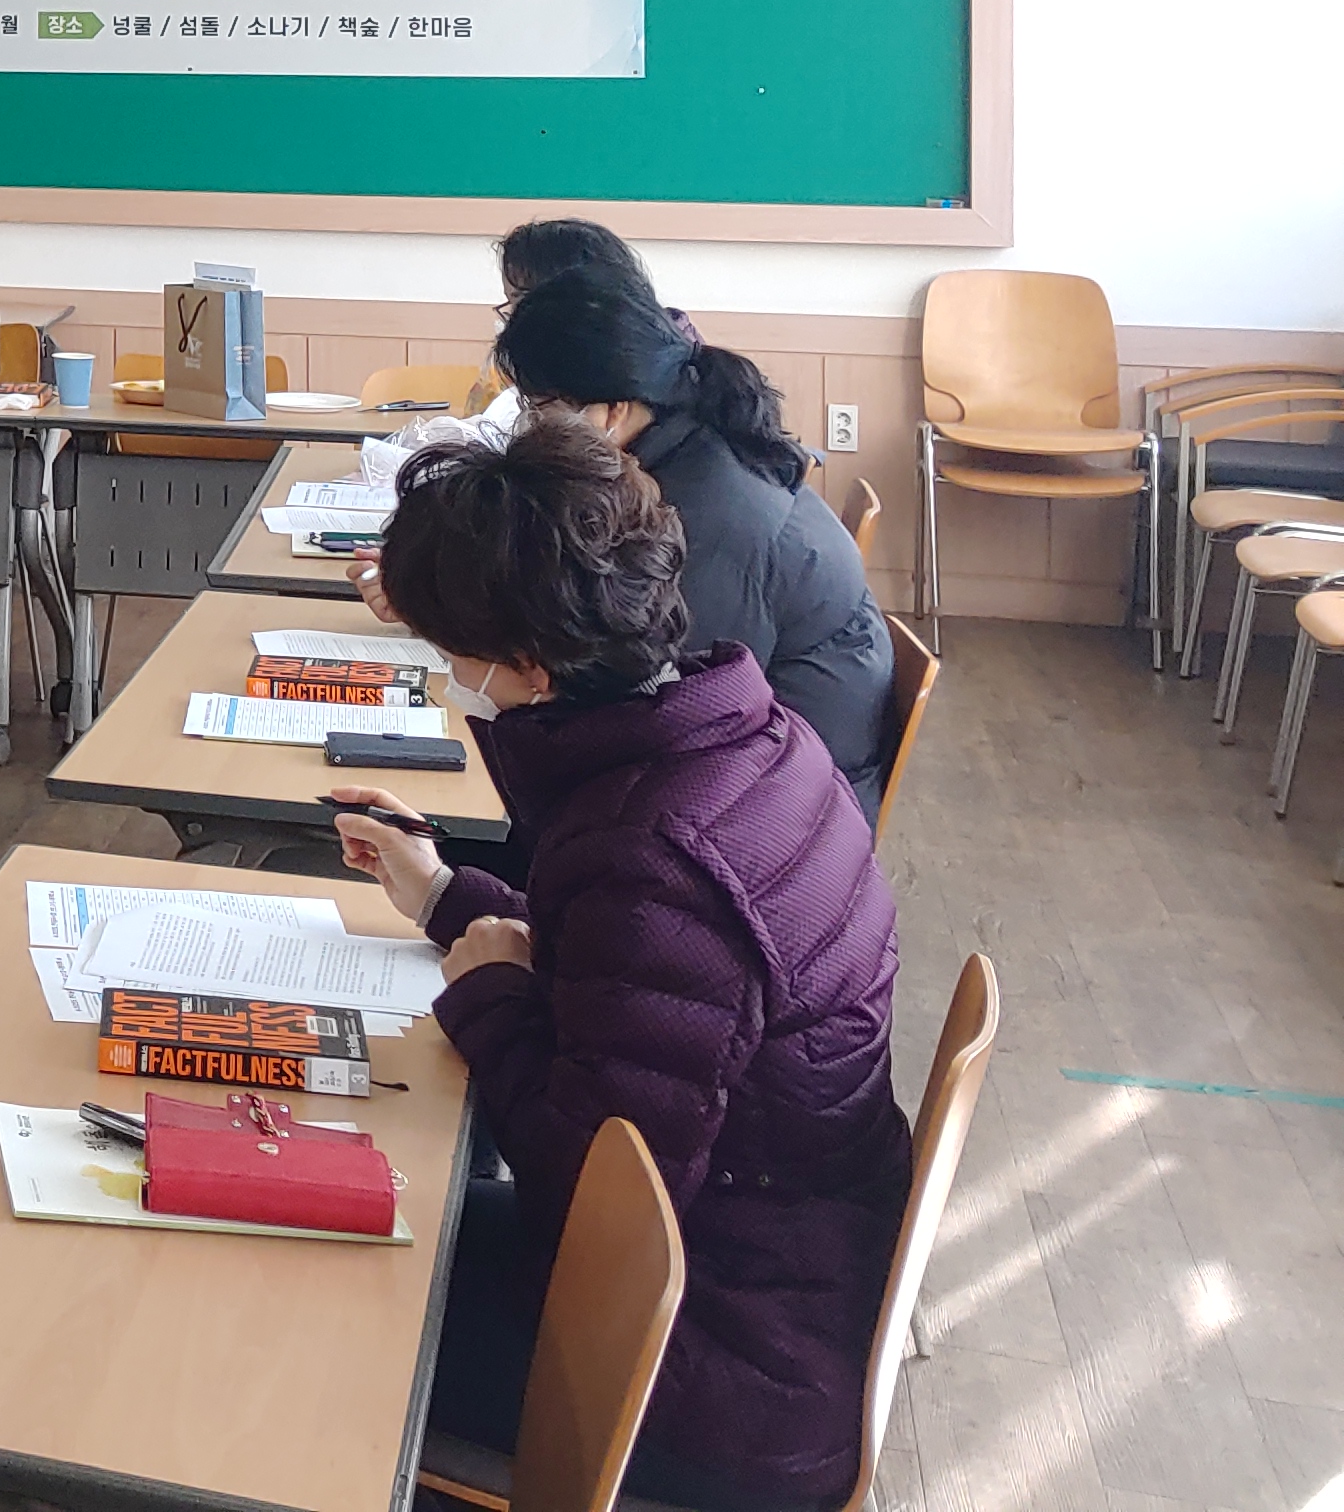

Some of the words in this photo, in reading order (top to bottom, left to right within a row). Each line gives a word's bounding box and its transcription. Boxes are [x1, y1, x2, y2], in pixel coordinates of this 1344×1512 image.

[47, 14, 83, 35] 장소
[112, 15, 152, 37] 넝쿨
[160, 15, 170, 37] /
[179, 15, 220, 37] 섬돌
[228, 15, 239, 37] /
[247, 15, 309, 37] 소나기
[318, 16, 330, 38] /
[338, 16, 380, 38] 책숲
[388, 16, 399, 38] /
[408, 16, 473, 38] 한마음
[278, 681, 385, 705] FACTFULNESS
[411, 694, 423, 704] 3
[111, 992, 179, 1040] FACT
[181, 1012, 250, 1047] FUL
